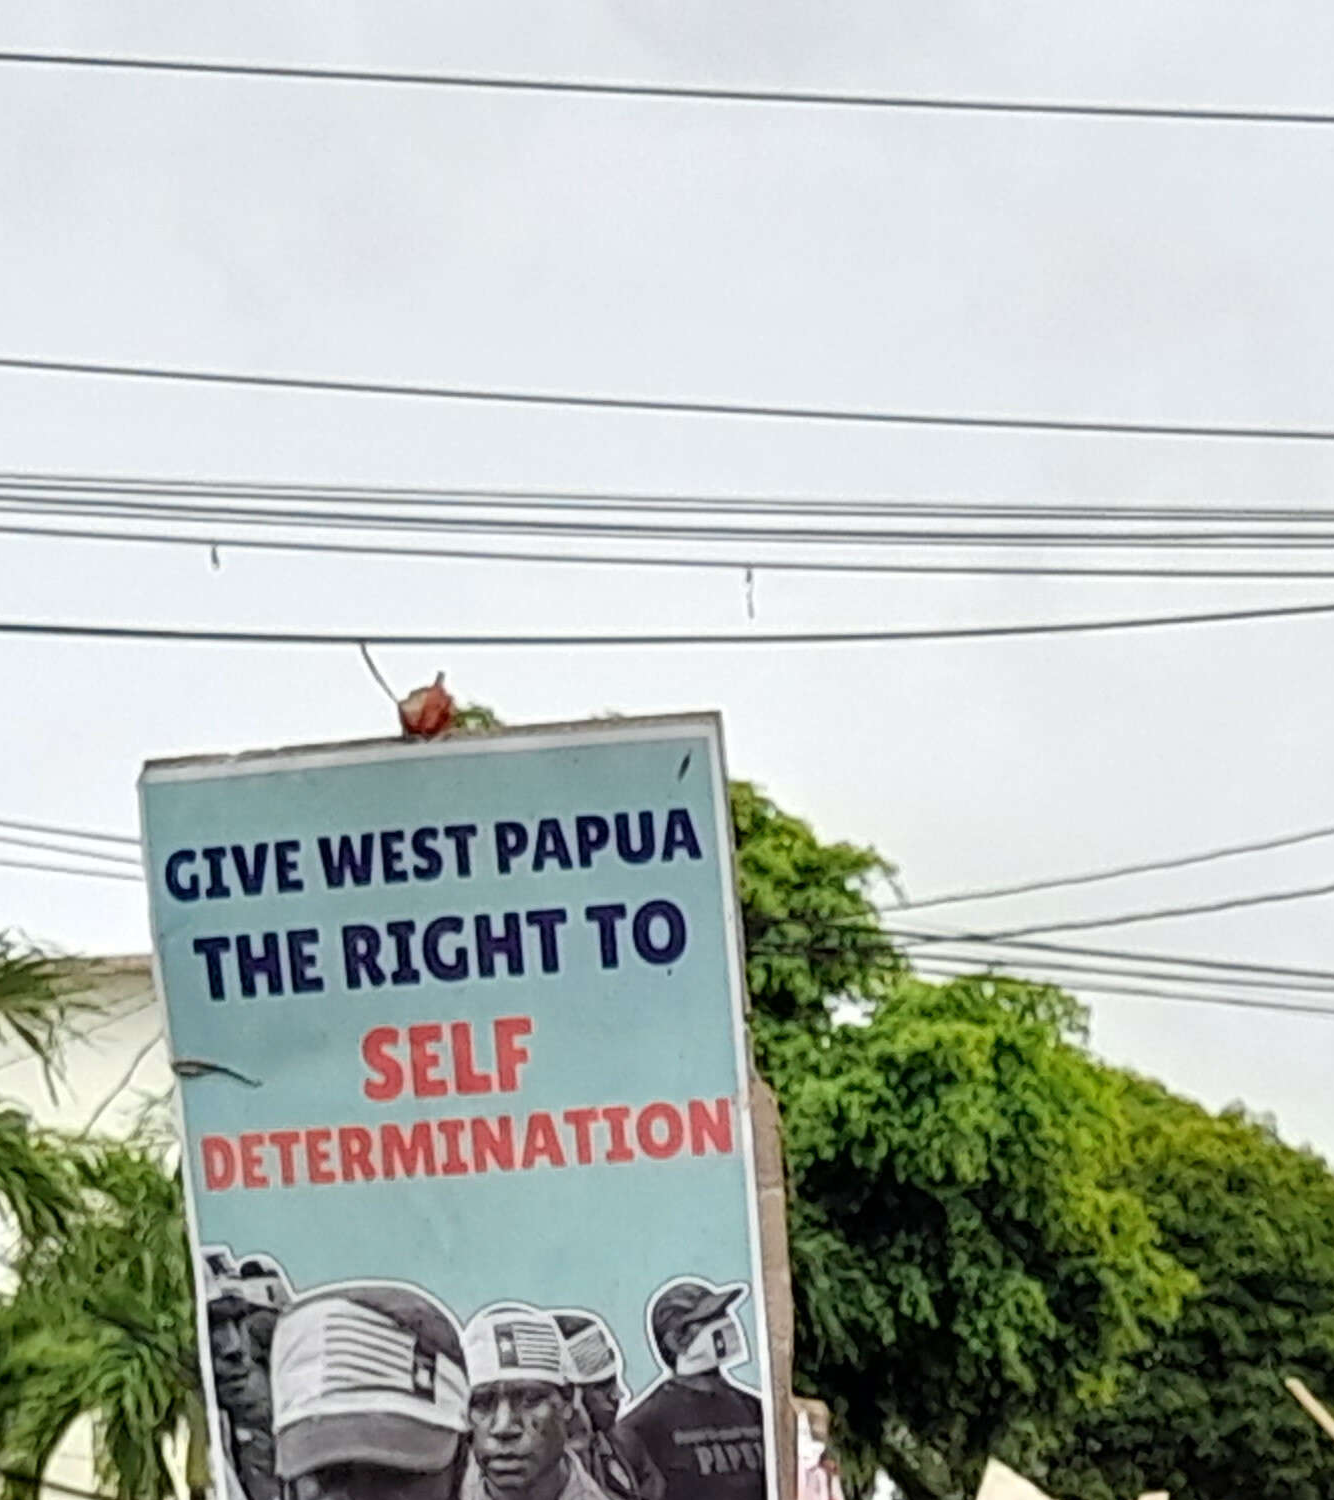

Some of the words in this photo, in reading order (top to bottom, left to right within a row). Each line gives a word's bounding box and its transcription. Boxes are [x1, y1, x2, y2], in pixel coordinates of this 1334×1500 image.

[166, 839, 304, 902] GIVE
[318, 823, 477, 889] WEST
[494, 808, 703, 875] PAPUA
[194, 929, 325, 1000] THE
[342, 908, 567, 990] RIGHT
[585, 898, 688, 970] TO
[361, 1016, 533, 1102] SELF
[200, 1097, 736, 1193] DETERMINATION
